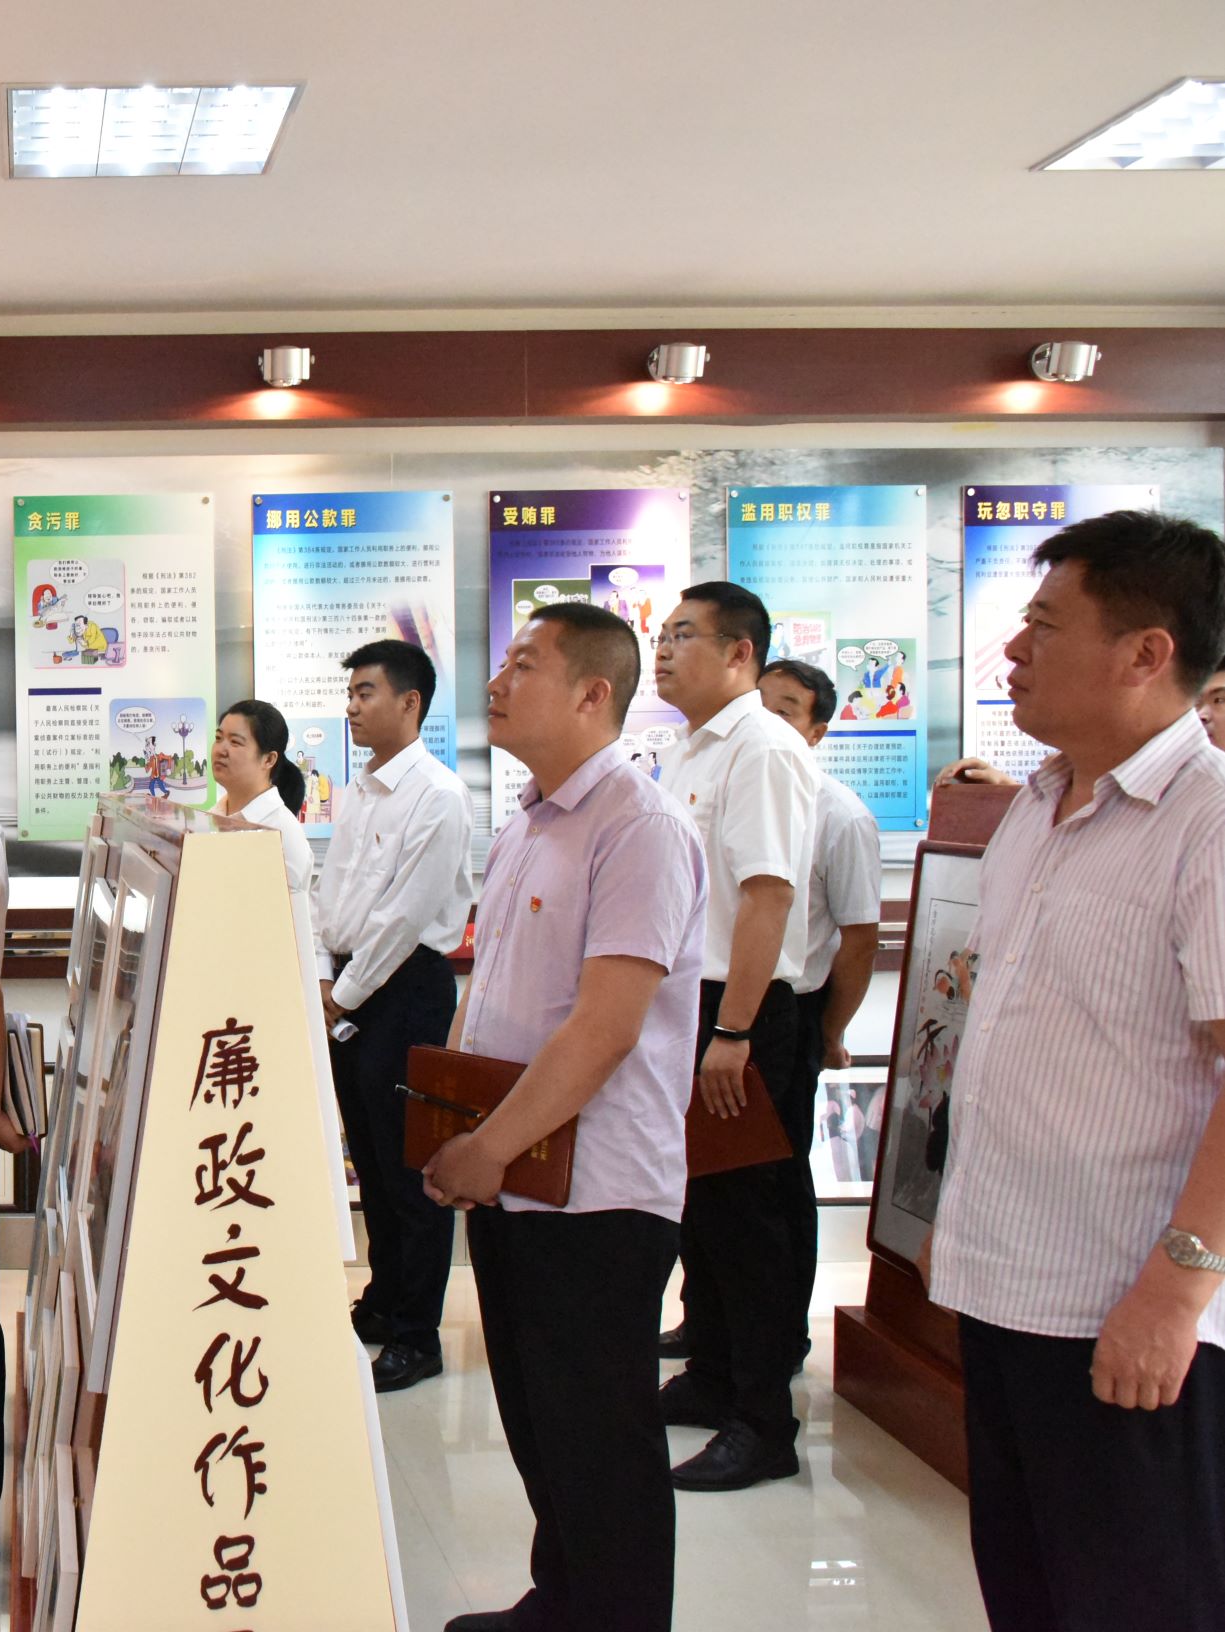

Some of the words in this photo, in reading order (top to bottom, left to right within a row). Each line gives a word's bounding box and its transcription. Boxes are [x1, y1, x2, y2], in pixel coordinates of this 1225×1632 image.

[266, 508, 357, 529] 挪用公款罪
[503, 506, 556, 526] 受贿罪
[741, 502, 831, 522] 滥用职权罪
[977, 501, 1066, 520] 玩忽职守罪
[27, 511, 81, 531] 贪污罪
[189, 1016, 276, 1632] 廉政文化作品
